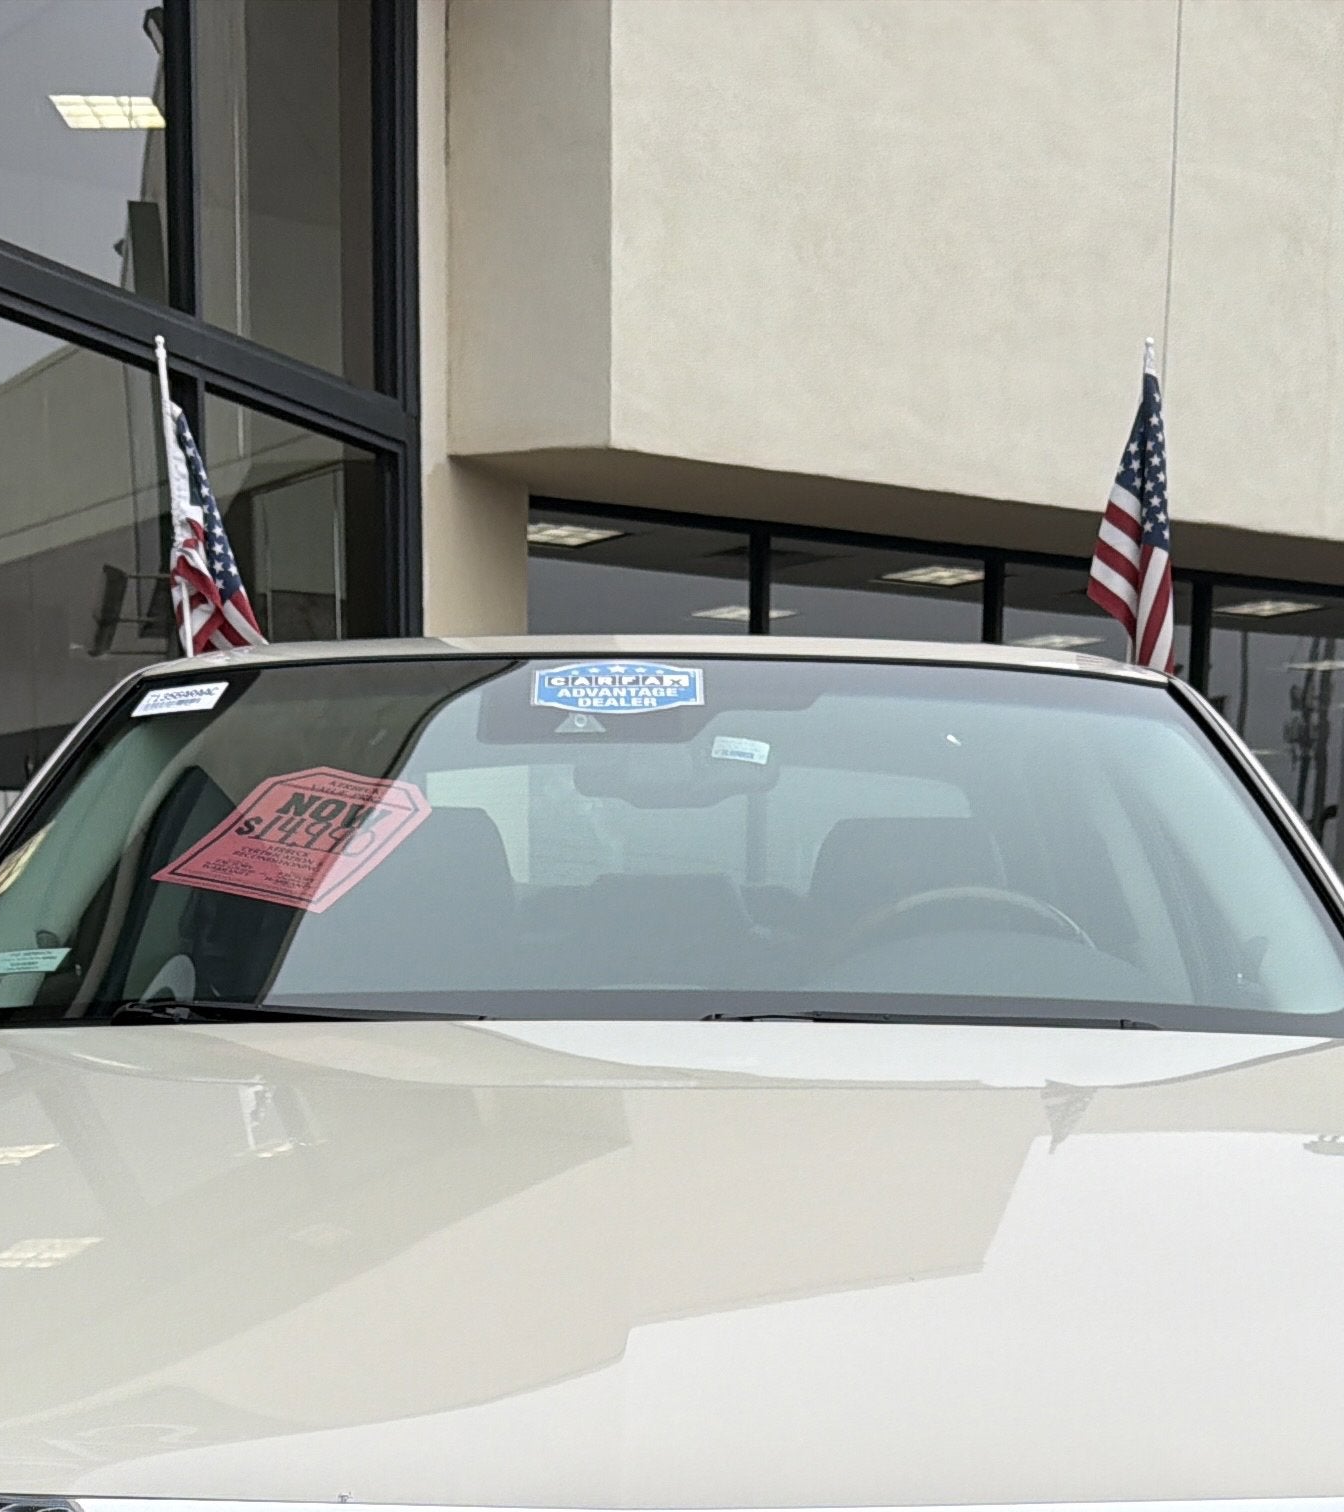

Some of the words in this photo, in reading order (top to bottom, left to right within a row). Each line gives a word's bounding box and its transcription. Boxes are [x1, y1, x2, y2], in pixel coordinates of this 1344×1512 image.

[547, 675, 689, 687] CARFAX
[557, 687, 678, 698] ADVANTAGE
[578, 697, 657, 707] DEALER
[276, 792, 392, 829] NOW
